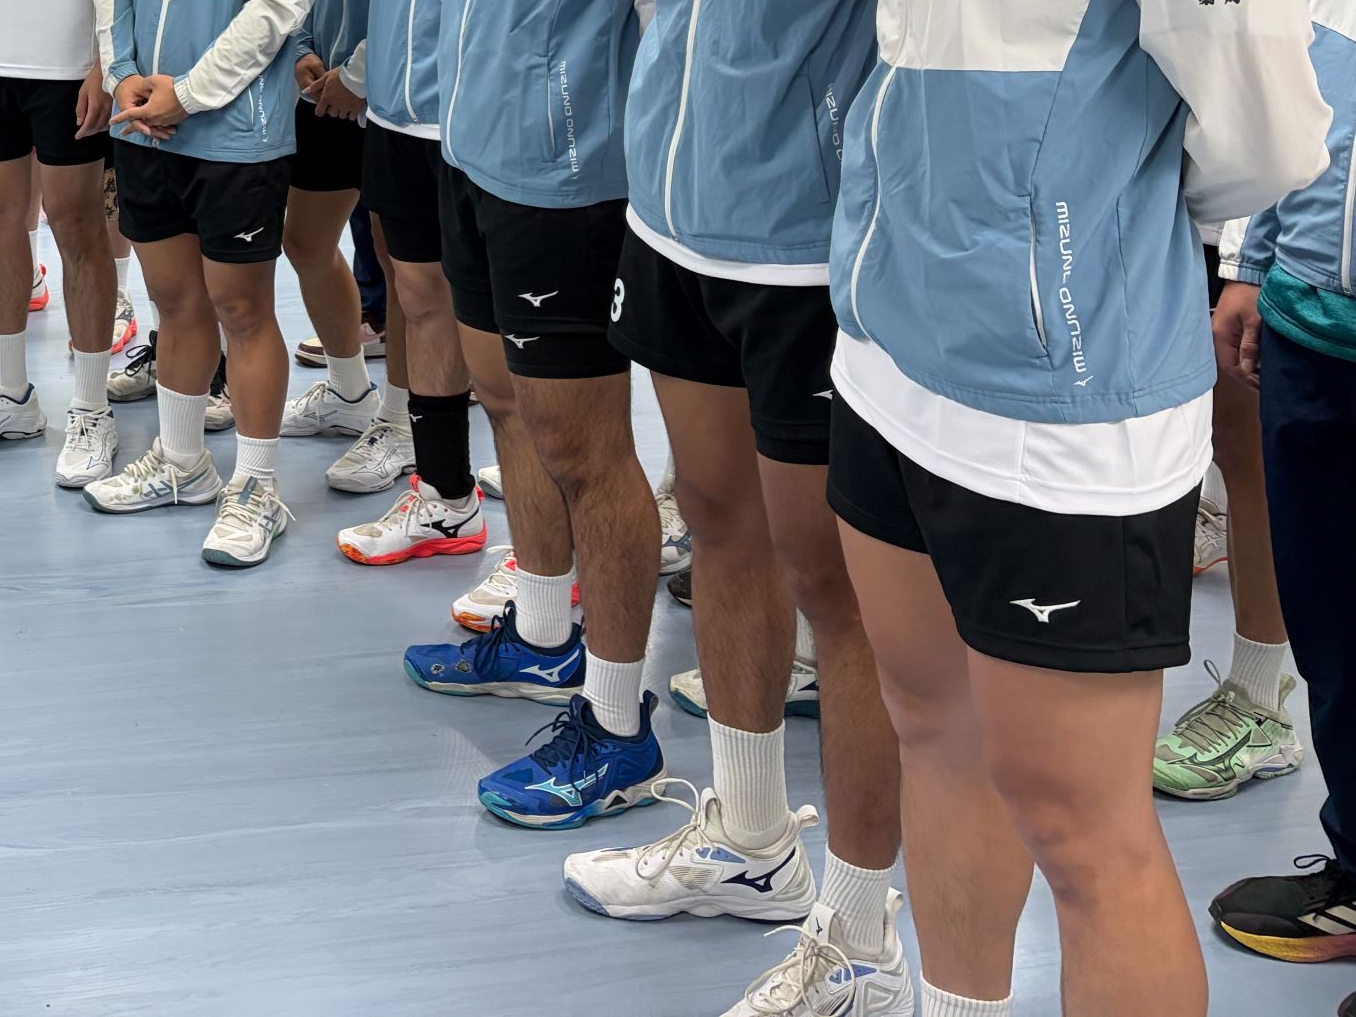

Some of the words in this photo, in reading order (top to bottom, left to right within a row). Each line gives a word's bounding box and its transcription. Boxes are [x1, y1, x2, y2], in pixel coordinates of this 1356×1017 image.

[559, 61, 573, 116] MIZUNO
[566, 118, 580, 173] MIZUNO
[1059, 287, 1087, 373] MIZUNO
